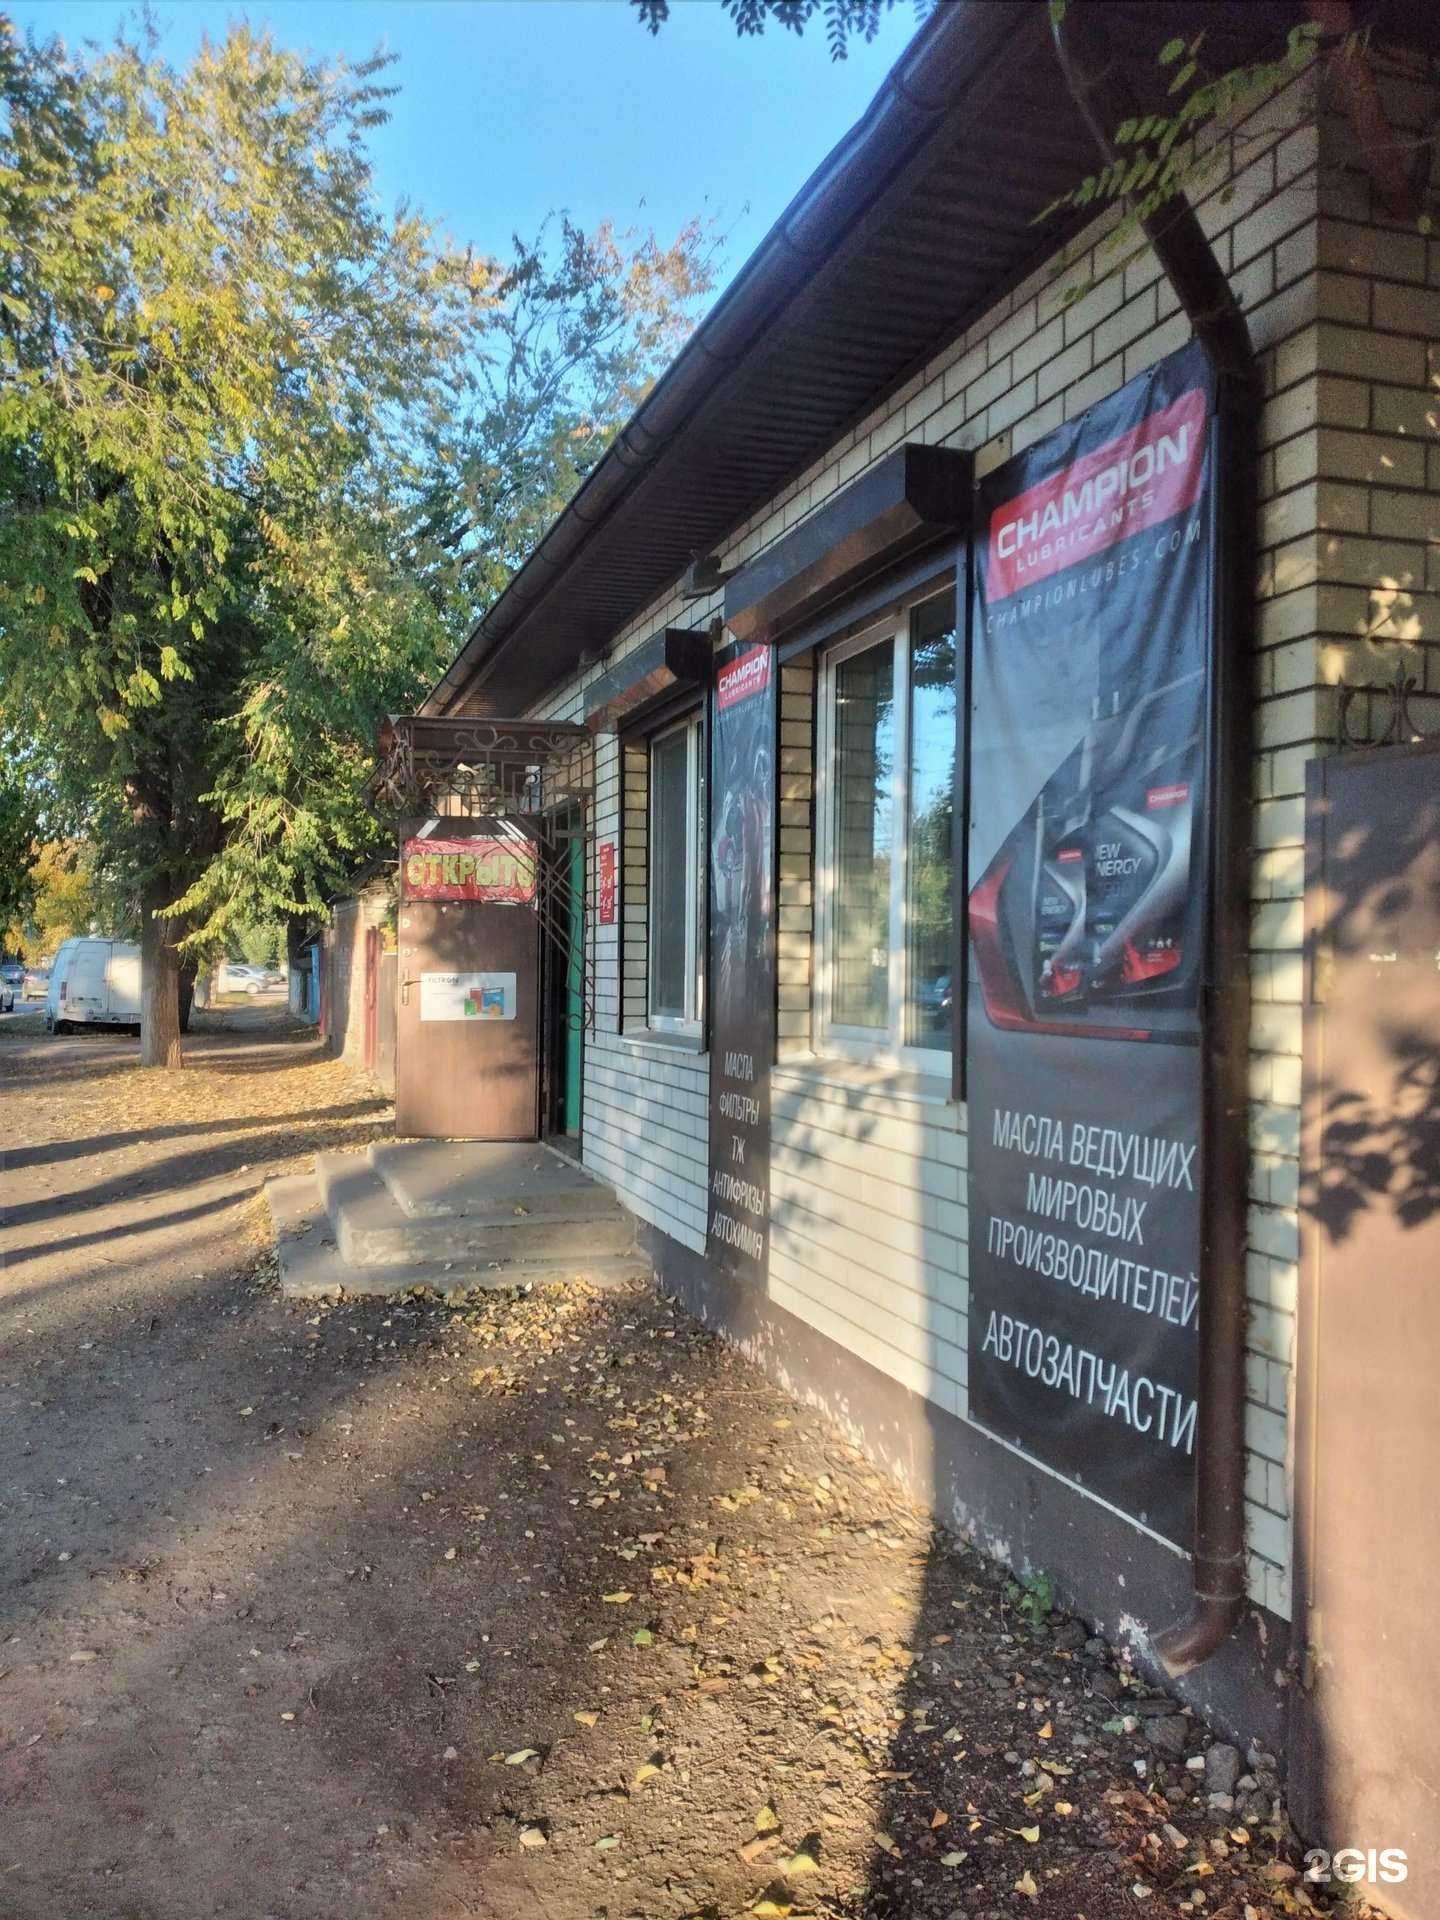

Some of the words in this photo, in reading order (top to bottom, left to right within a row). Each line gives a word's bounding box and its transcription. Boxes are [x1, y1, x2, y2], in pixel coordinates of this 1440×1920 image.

[997, 424, 1189, 559] CHAMPION
[1017, 489, 1155, 573] LUBRICANTS
[719, 651, 769, 692] CHAMPION
[1097, 857, 1142, 877] NERGY
[724, 1051, 754, 1081] МАСЛА
[719, 1091, 760, 1127] ФИЛЬТРЫ
[731, 1135, 745, 1165] ТЖ
[992, 1108, 1064, 1163] МАСЛА
[1069, 1122, 1197, 1192] ВЕДУЩИХ
[712, 1170, 766, 1217] АНТИФРИЗЫ
[1026, 1172, 1148, 1246] МИРОВЫХ
[711, 1210, 763, 1261] АВТОХИМИЯ
[988, 1216, 1200, 1332] ПРОИЗВОДИТЕЛЕЙ
[982, 1310, 1198, 1455] АВТОЗАПЧАСТИ
